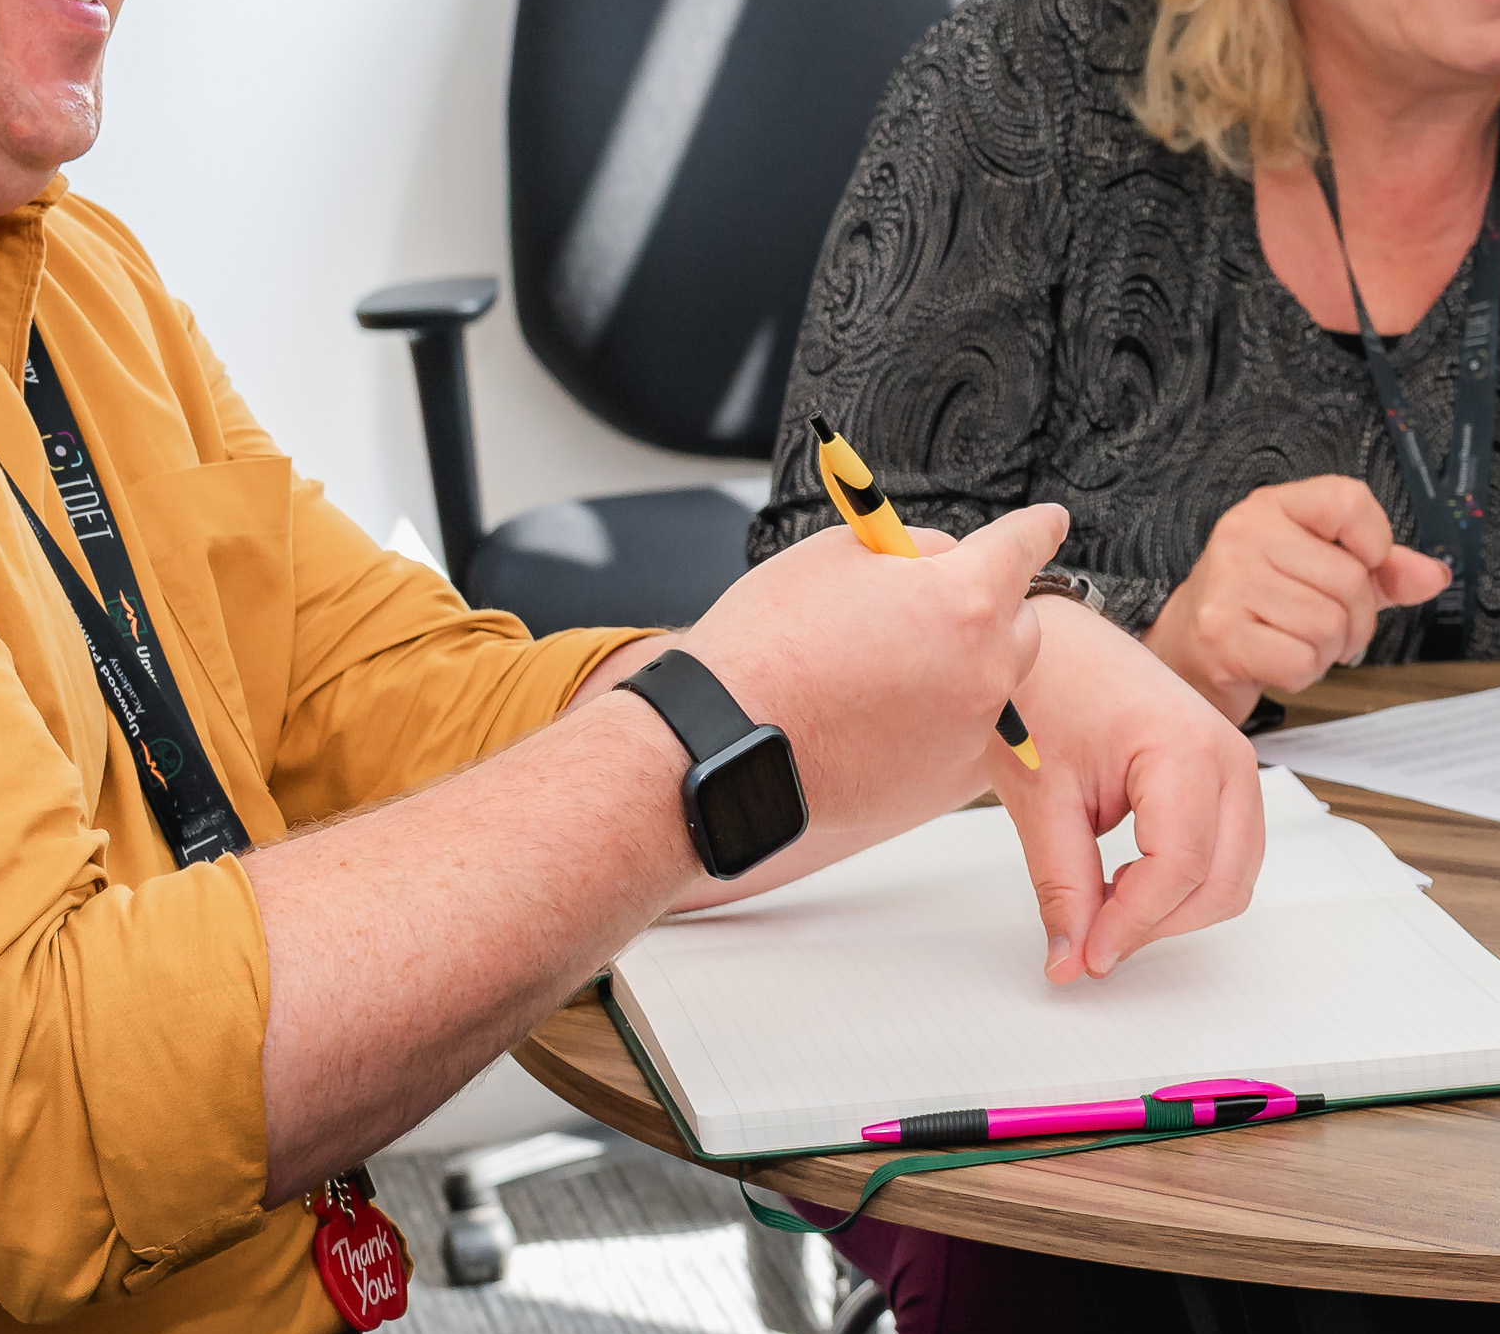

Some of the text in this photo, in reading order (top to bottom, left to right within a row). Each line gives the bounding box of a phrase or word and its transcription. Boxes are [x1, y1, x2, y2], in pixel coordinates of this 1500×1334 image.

[57, 473, 113, 540] TDET
[99, 664, 141, 738] Upwood
[108, 657, 146, 715] Academy
[331, 1223, 394, 1277] Thank
[351, 1259, 398, 1316] You!
